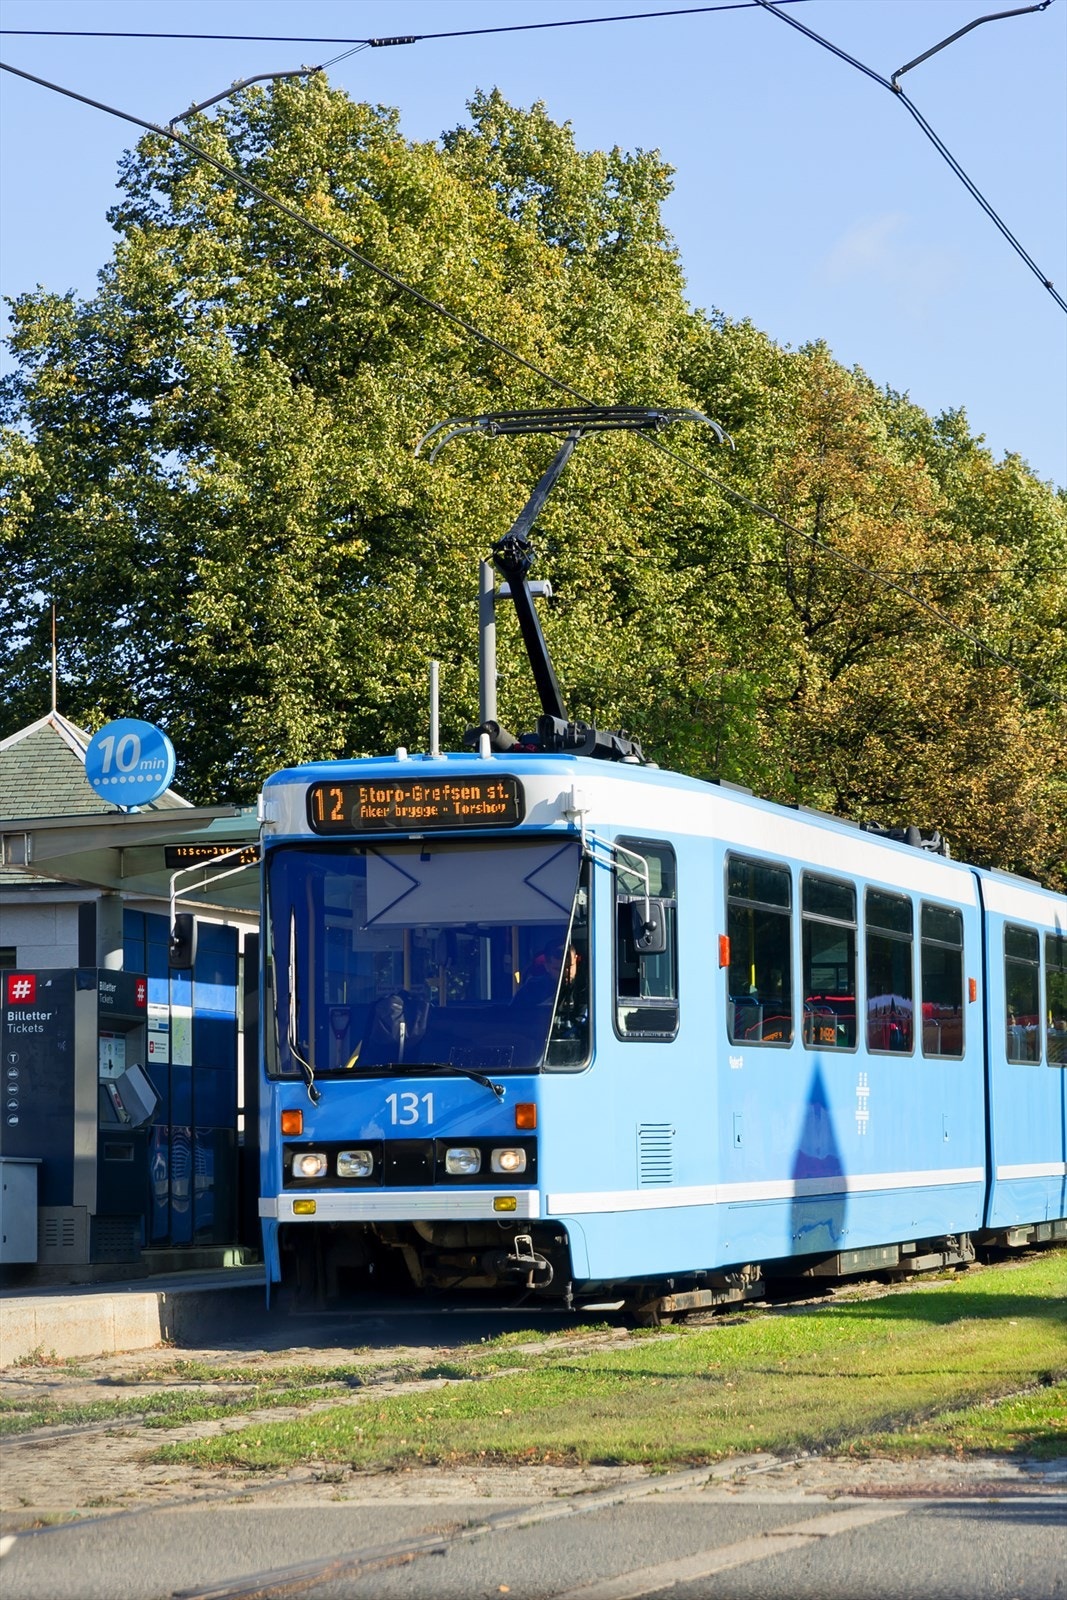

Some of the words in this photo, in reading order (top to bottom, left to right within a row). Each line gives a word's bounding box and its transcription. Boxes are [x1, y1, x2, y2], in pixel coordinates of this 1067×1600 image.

[97, 733, 142, 774] 10
[140, 757, 165, 770] min
[359, 784, 480, 804] Storo-Grefsen
[487, 783, 509, 799] st.
[315, 788, 344, 821] 12
[395, 804, 438, 818] brygge
[453, 801, 506, 815] Torshov
[7, 1011, 52, 1021] Billetter
[7, 1023, 44, 1033] Tickets
[385, 1092, 433, 1125] 131
